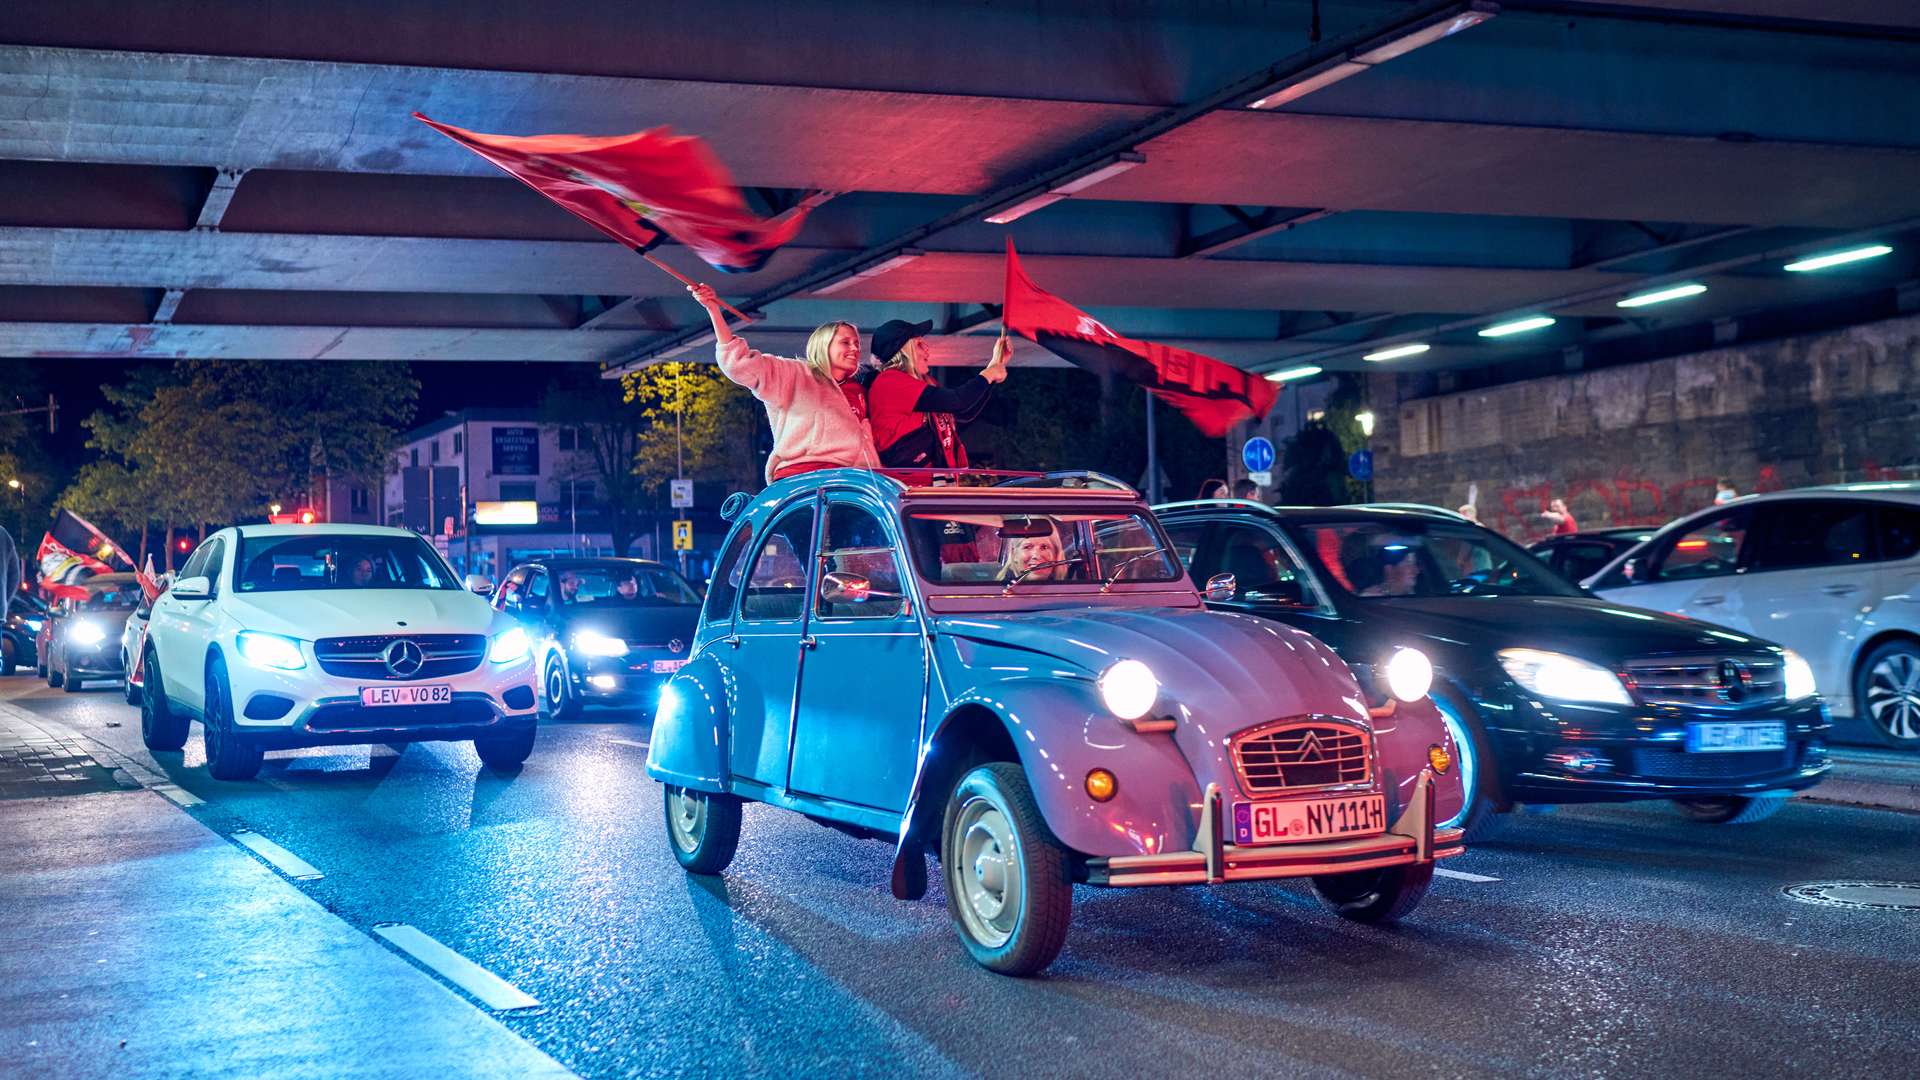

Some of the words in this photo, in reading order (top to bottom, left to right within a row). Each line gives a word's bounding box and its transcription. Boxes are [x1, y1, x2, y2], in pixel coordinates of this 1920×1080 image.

[371, 688, 400, 704] LEV
[410, 688, 429, 702] VO
[432, 687, 449, 701] 82
[1255, 807, 1289, 838] GL
